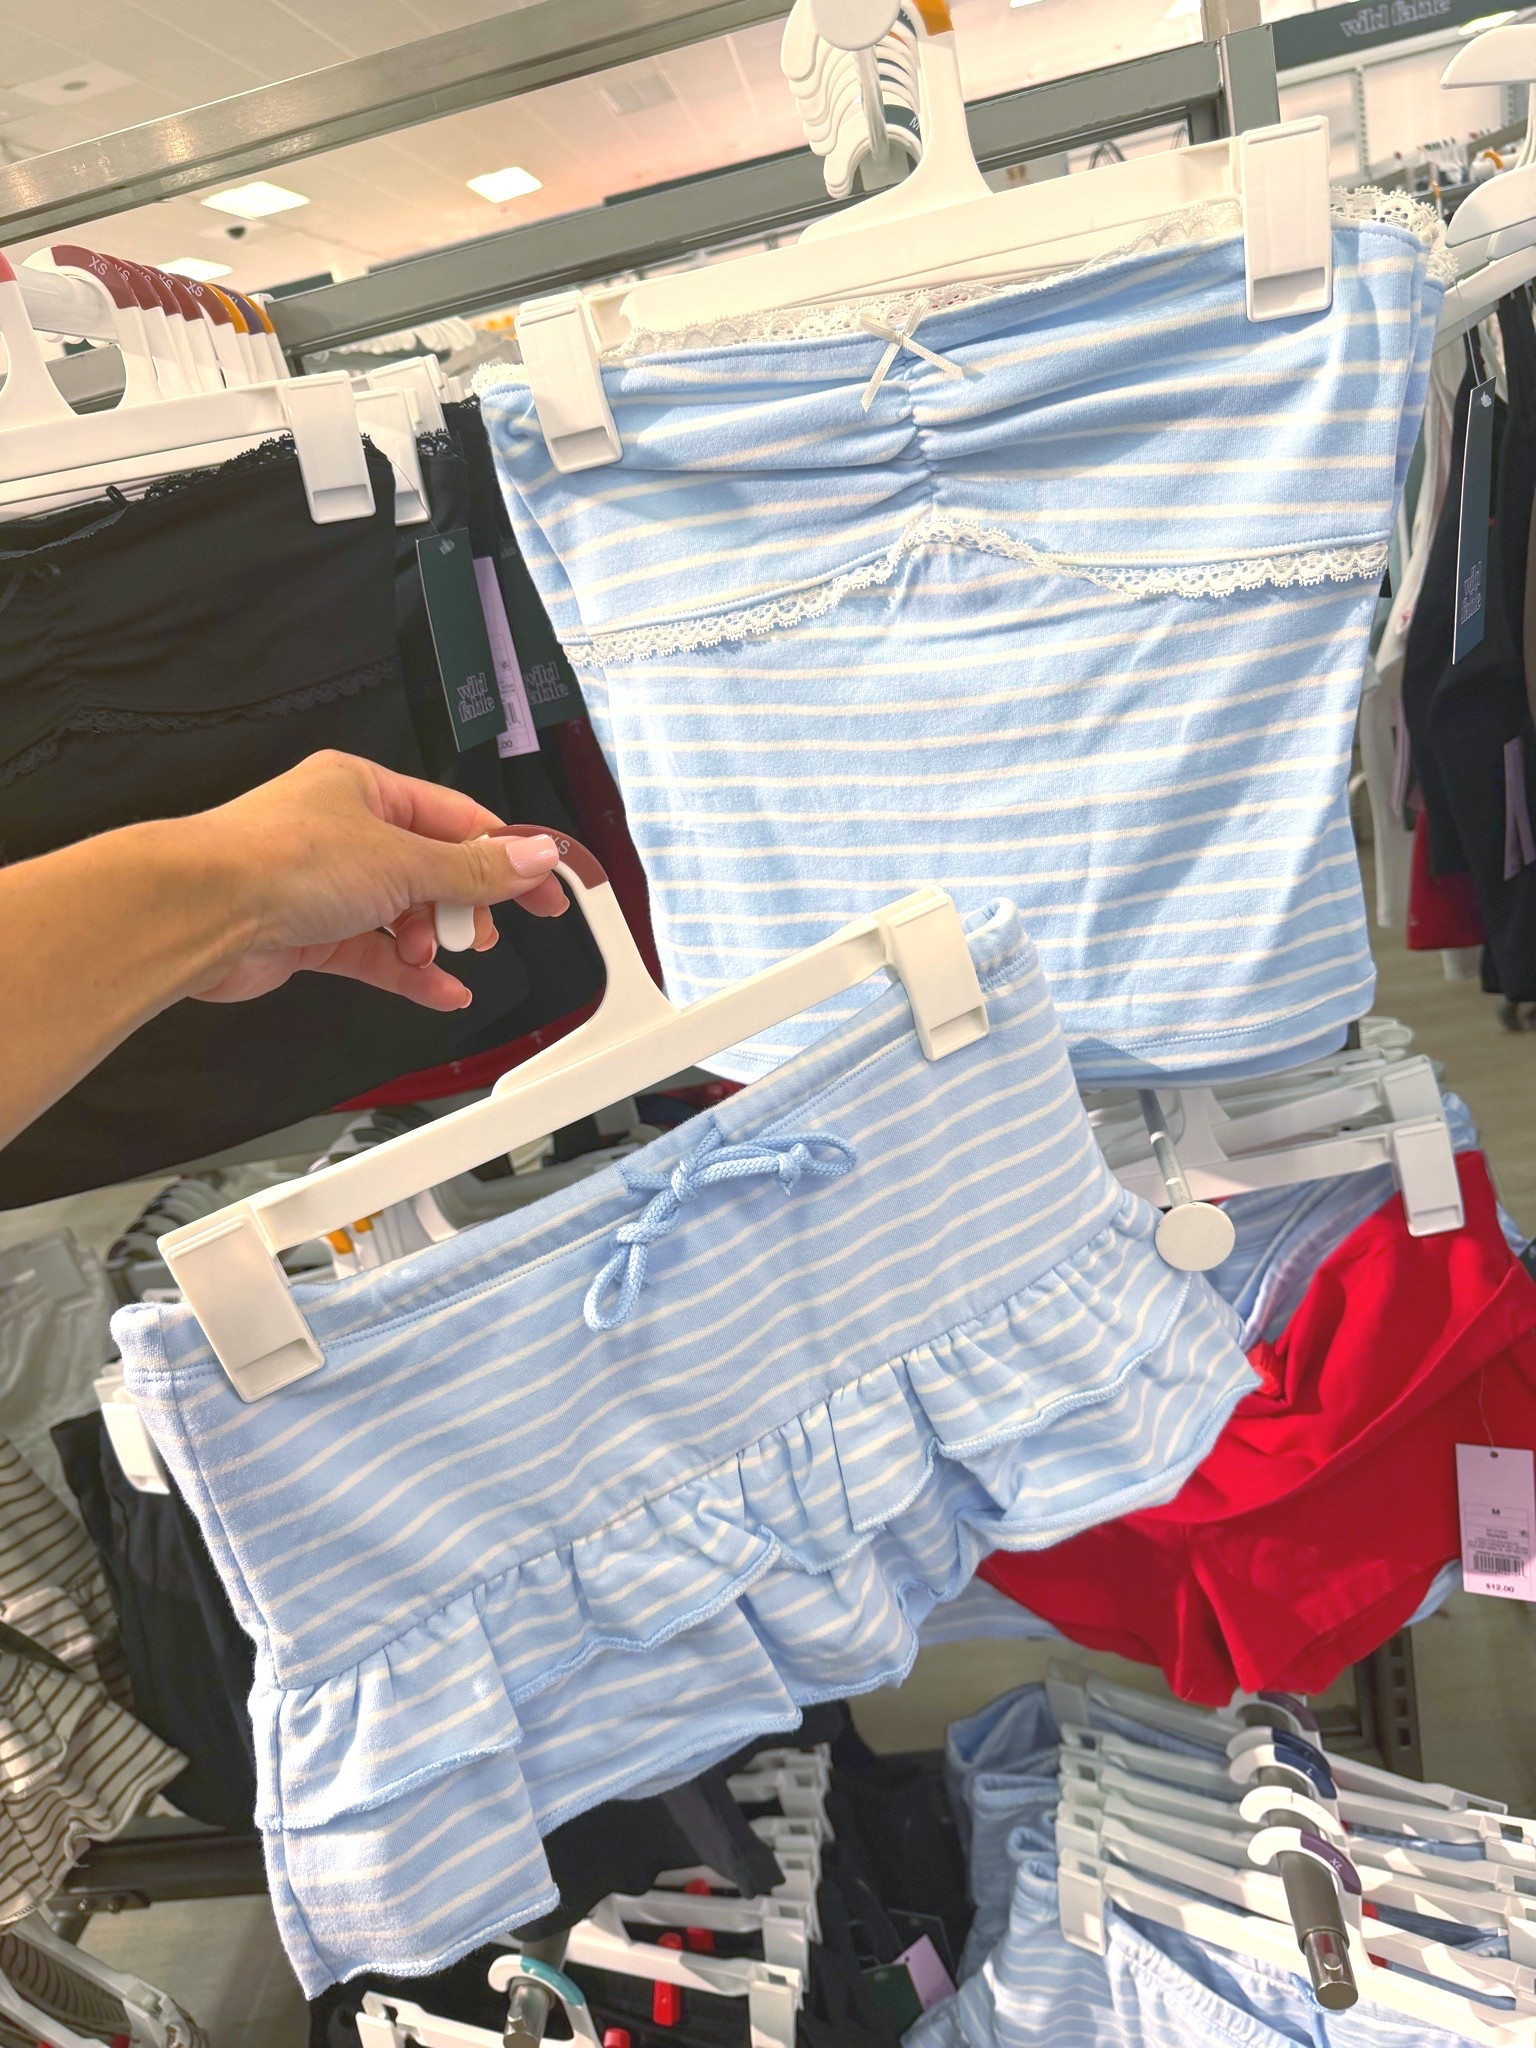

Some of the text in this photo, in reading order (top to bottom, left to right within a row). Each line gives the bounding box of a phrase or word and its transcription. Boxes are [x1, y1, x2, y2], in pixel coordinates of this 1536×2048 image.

[1340, 0, 1452, 37] wild fable
[88, 256, 108, 276] XS
[187, 280, 204, 297] XS
[457, 671, 489, 700] wild
[458, 694, 496, 723] fable
[1491, 1508, 1500, 1516] M
[1330, 1858, 1342, 1870] XL
